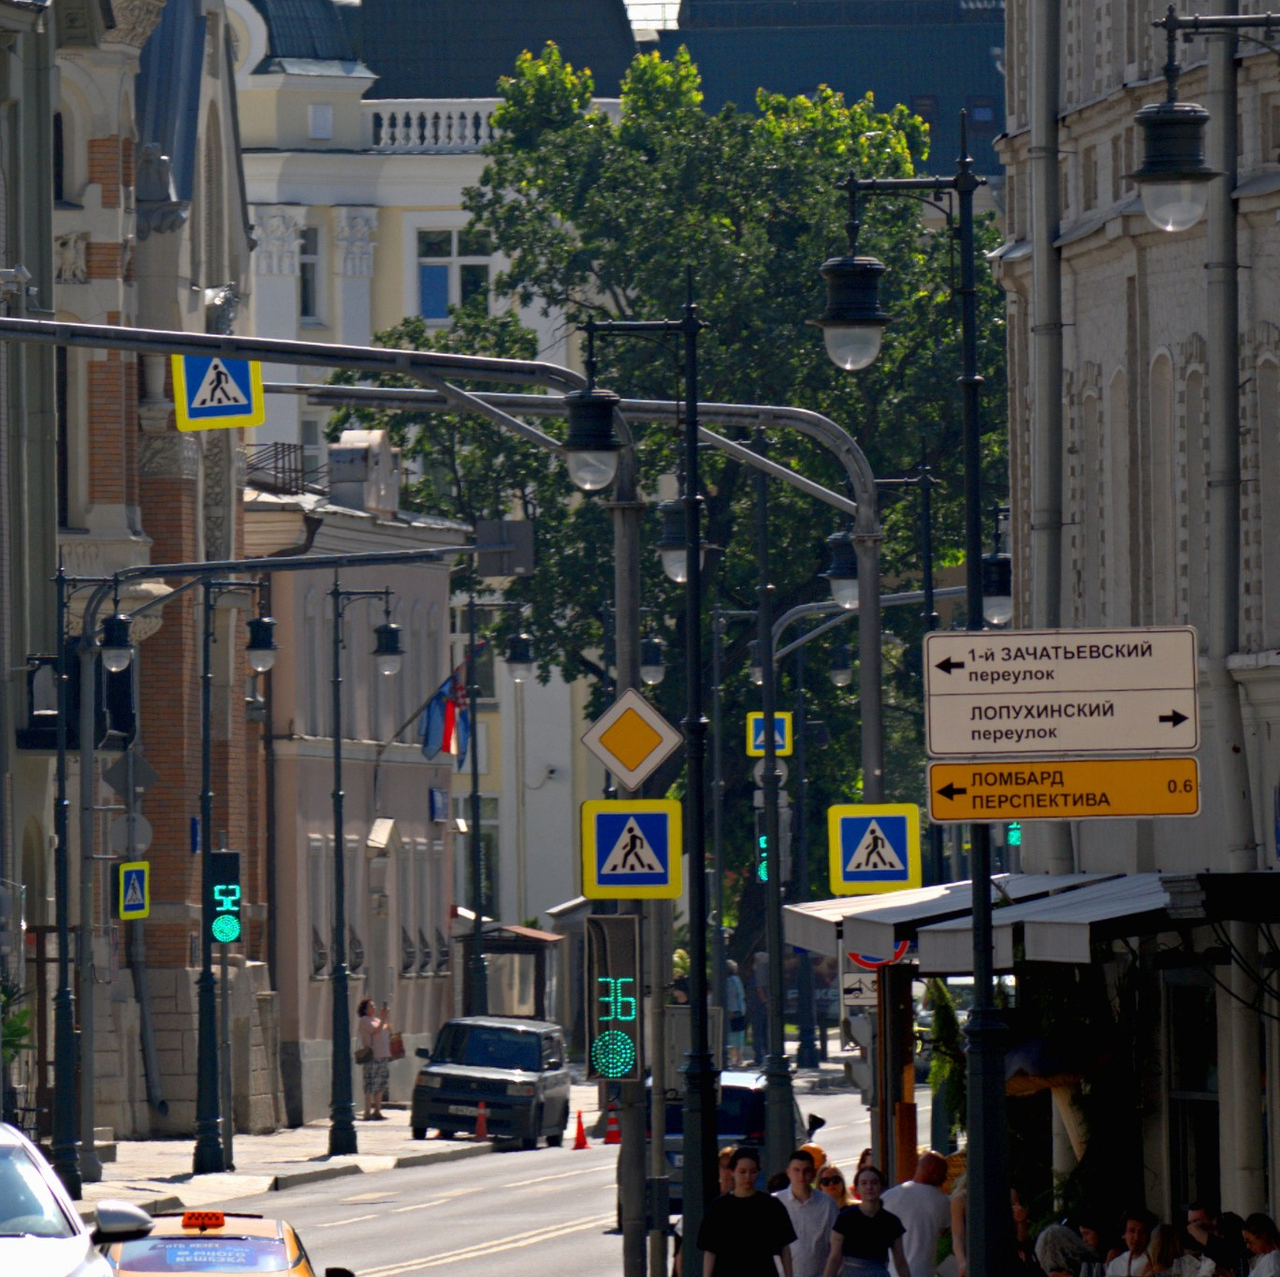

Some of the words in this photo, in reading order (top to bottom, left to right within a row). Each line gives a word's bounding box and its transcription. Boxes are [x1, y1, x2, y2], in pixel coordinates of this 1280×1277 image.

[968, 647, 995, 662] 1-й
[1001, 641, 1153, 662] ЗАЧАТЬЕВСКИЙ
[968, 669, 1056, 685] переулок
[970, 700, 1115, 721] ЛОПУХИНСКИЙ
[971, 727, 1058, 743] переулок
[971, 770, 1065, 788] ЛОМБАРД
[1167, 779, 1193, 794] 0.6
[972, 793, 1111, 810] ПЕРСПЕКТИВА
[214, 885, 241, 911] 52
[598, 977, 636, 1021] 36
